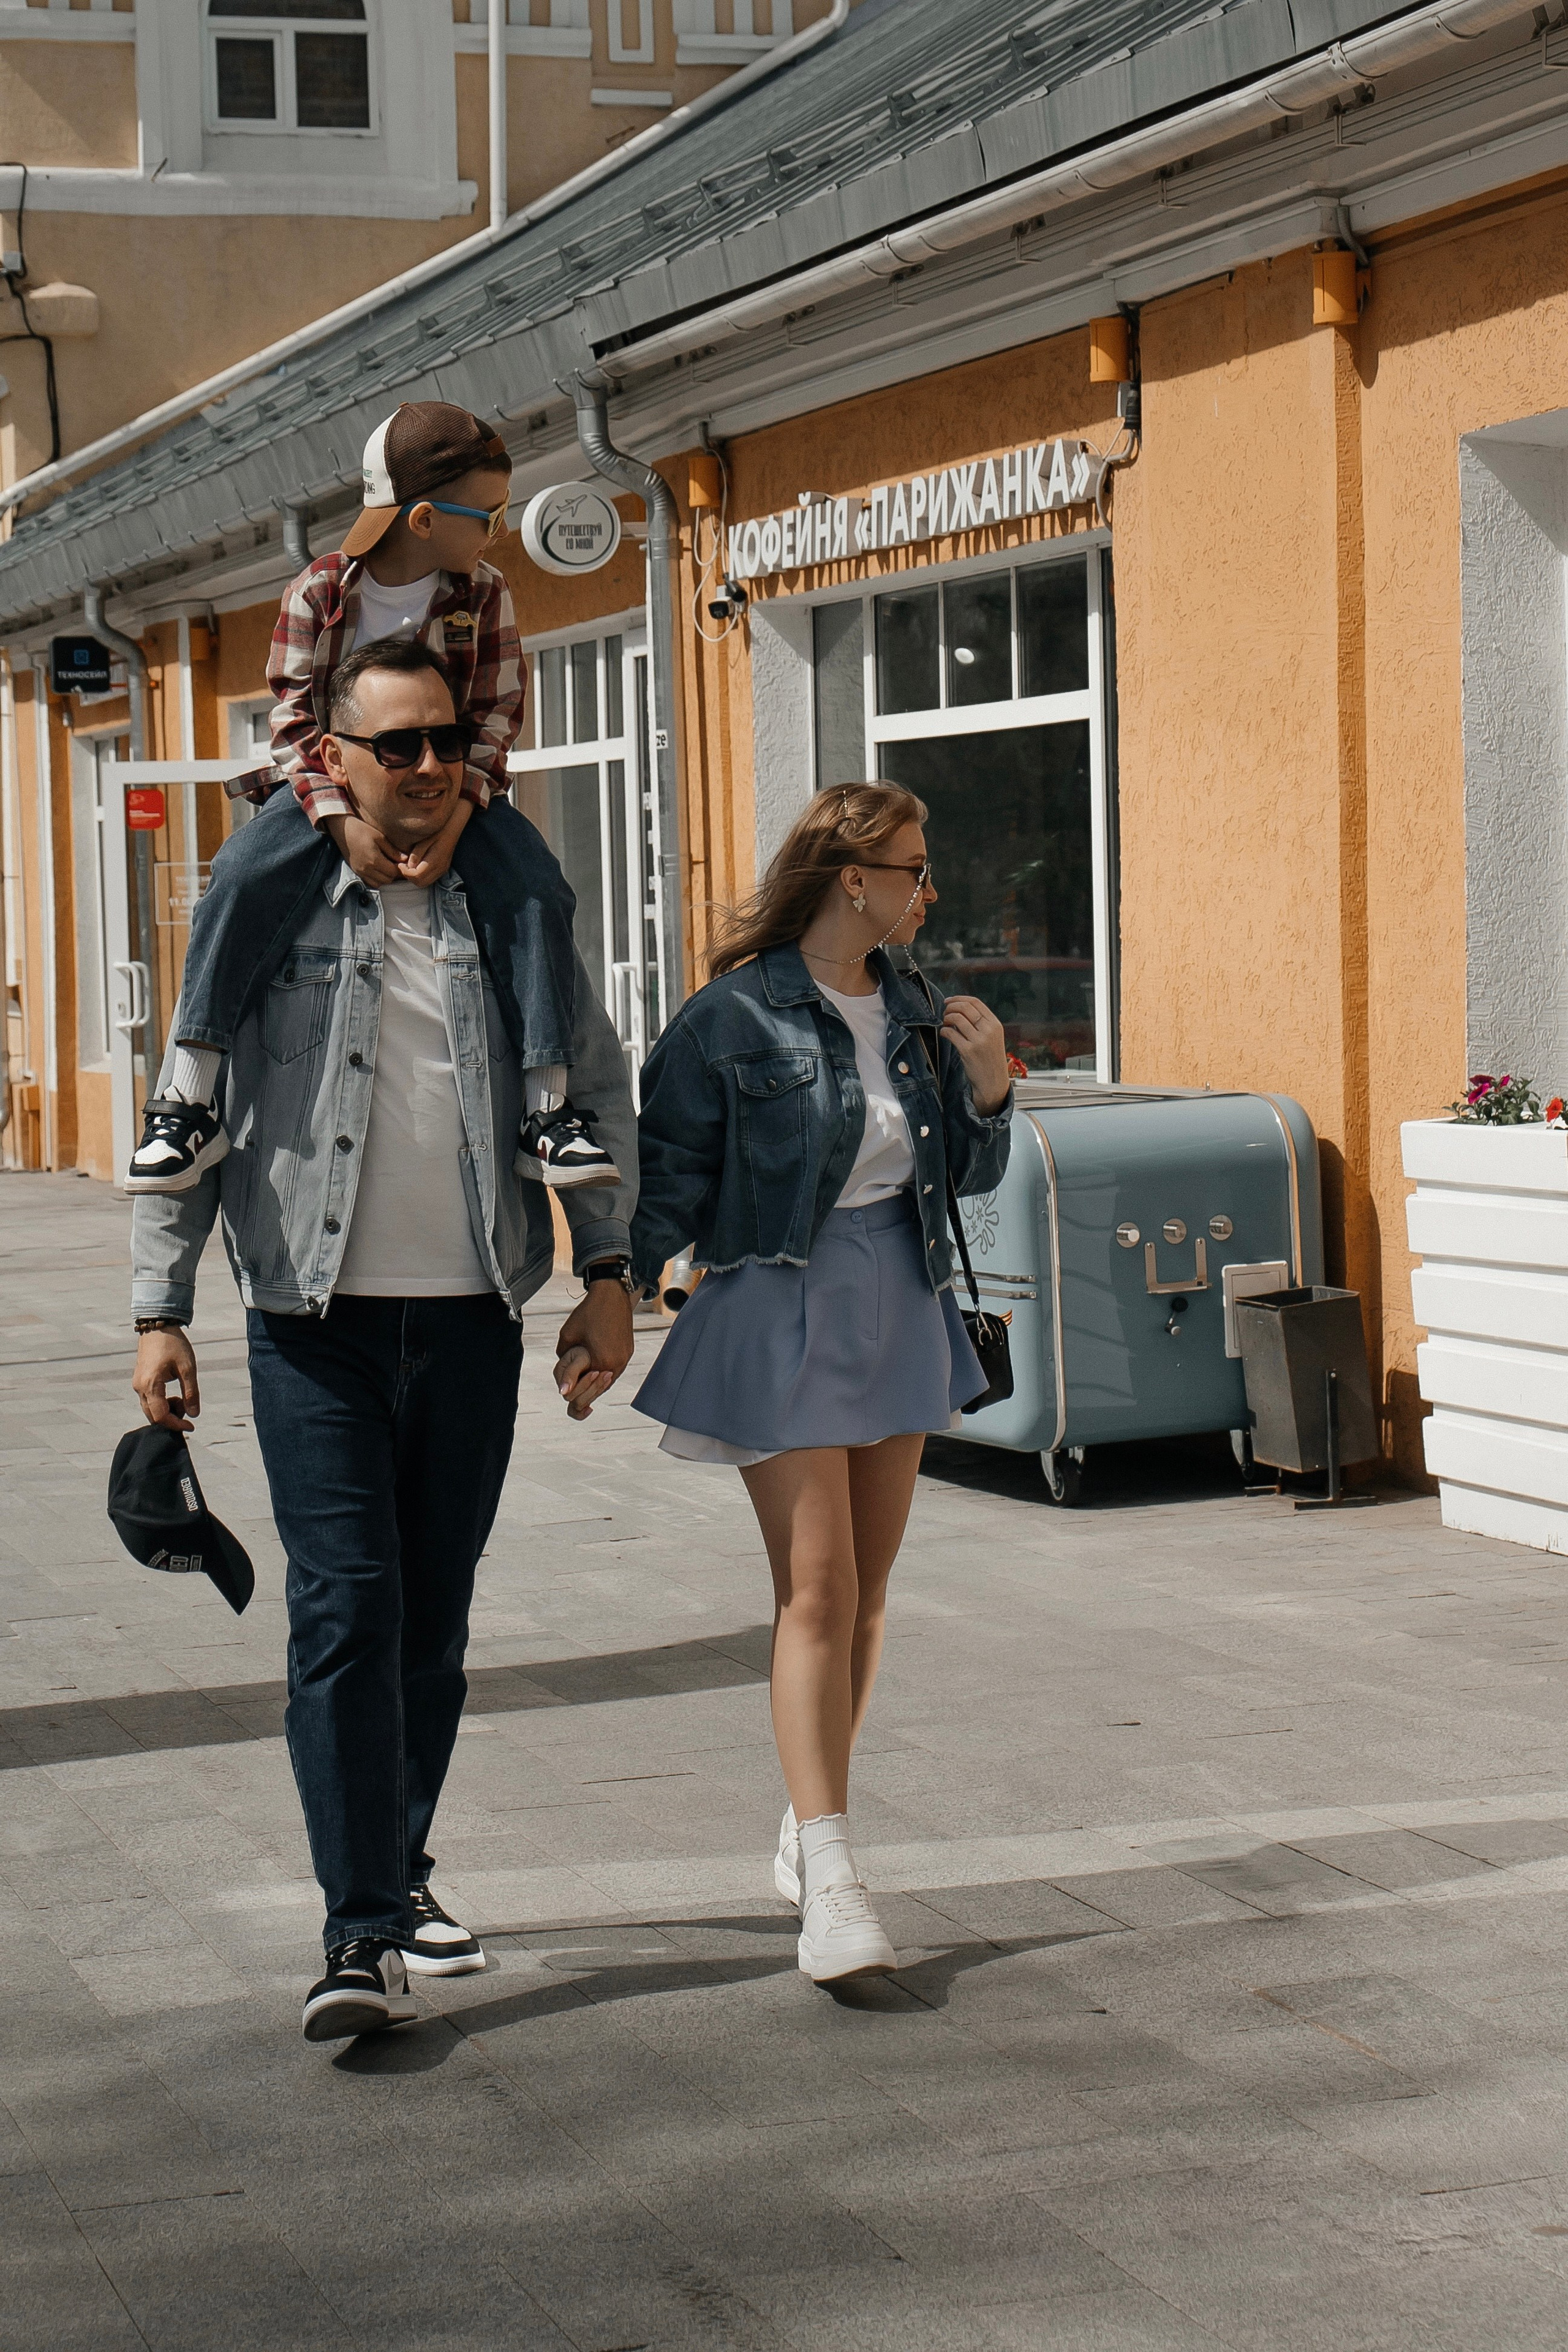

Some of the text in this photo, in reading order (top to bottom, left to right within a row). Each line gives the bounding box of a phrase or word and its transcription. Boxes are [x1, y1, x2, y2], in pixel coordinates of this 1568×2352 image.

[728, 438, 1091, 581] КОФЕЙНЯ «ПАРИЖАНКА»
[559, 523, 602, 537] ПУТЕШЕСТВУЙ
[58, 670, 108, 679] ТЕХНОСЕЙЛ
